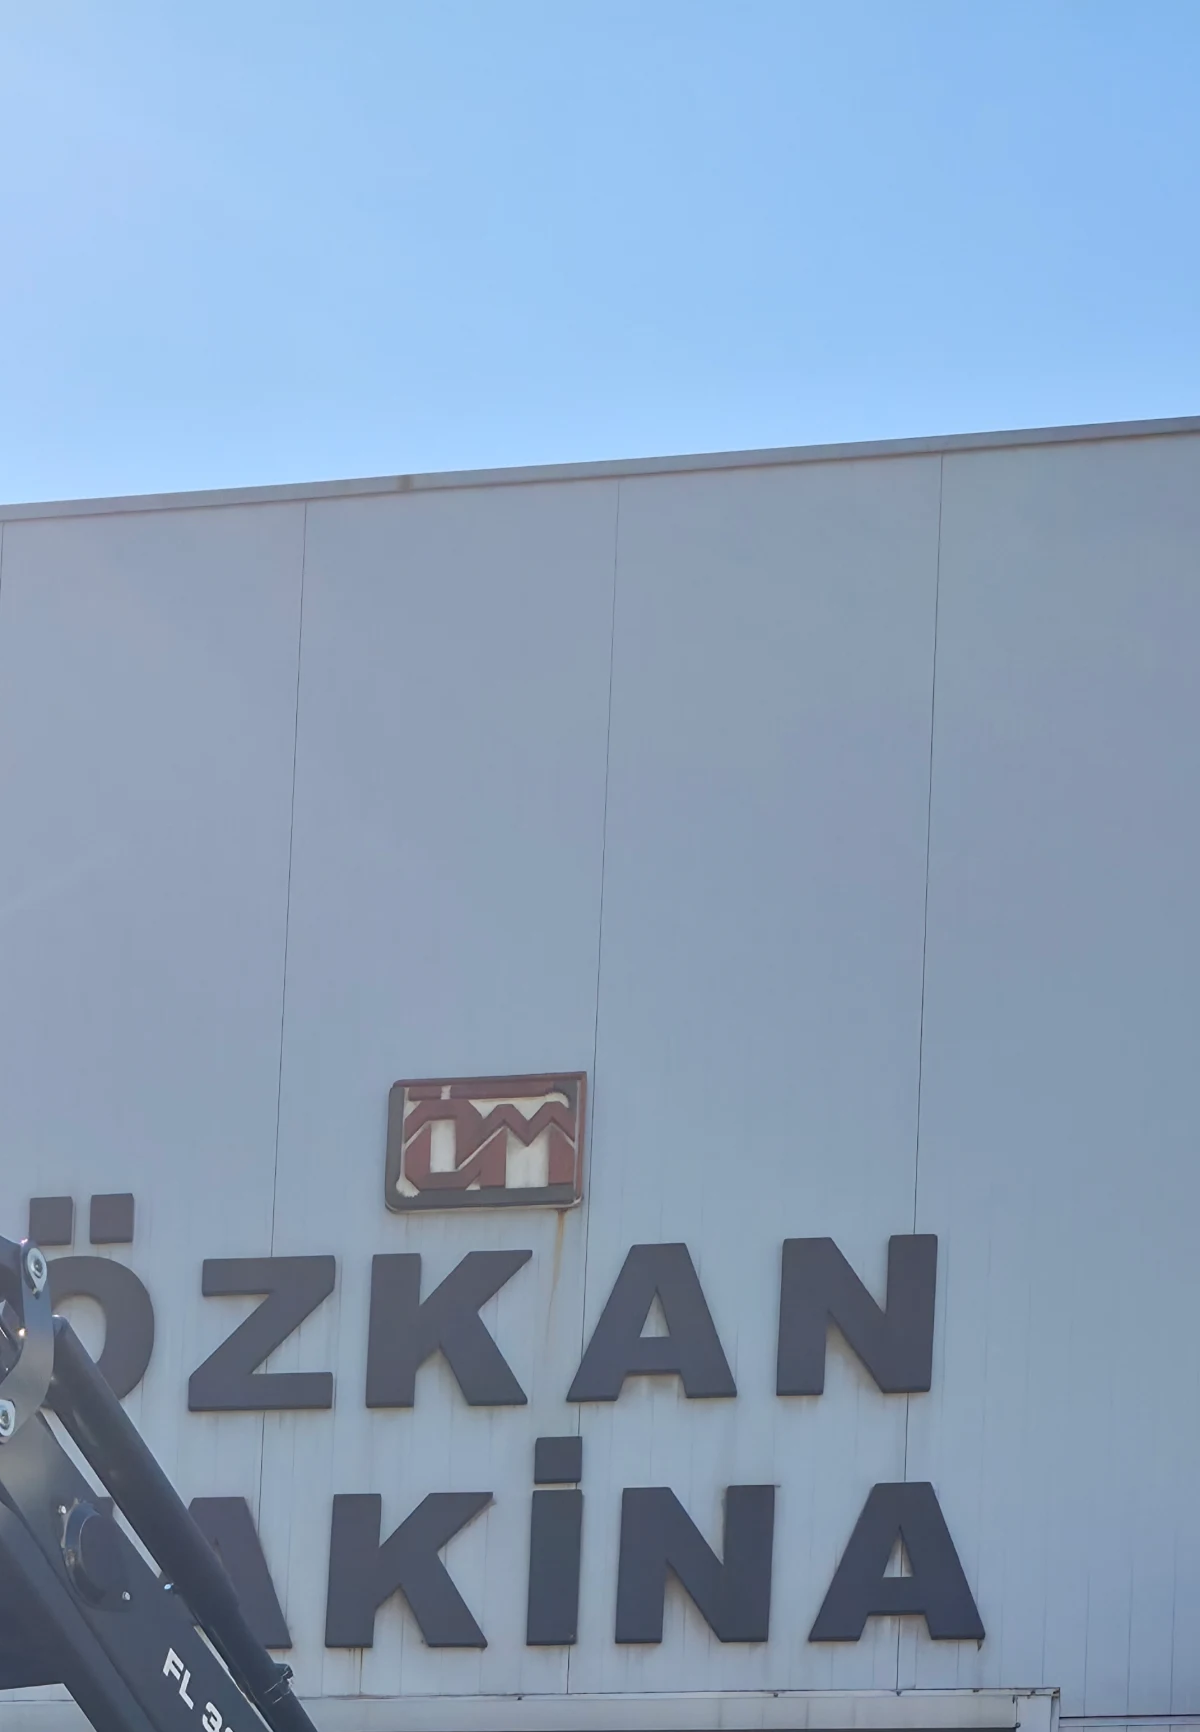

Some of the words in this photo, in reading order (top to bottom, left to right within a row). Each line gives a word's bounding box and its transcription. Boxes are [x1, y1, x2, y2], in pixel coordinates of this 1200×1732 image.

[29, 1192, 938, 1411] ÖZKAN
[186, 1435, 987, 1648] KİNA
[162, 1647, 194, 1710] FL
